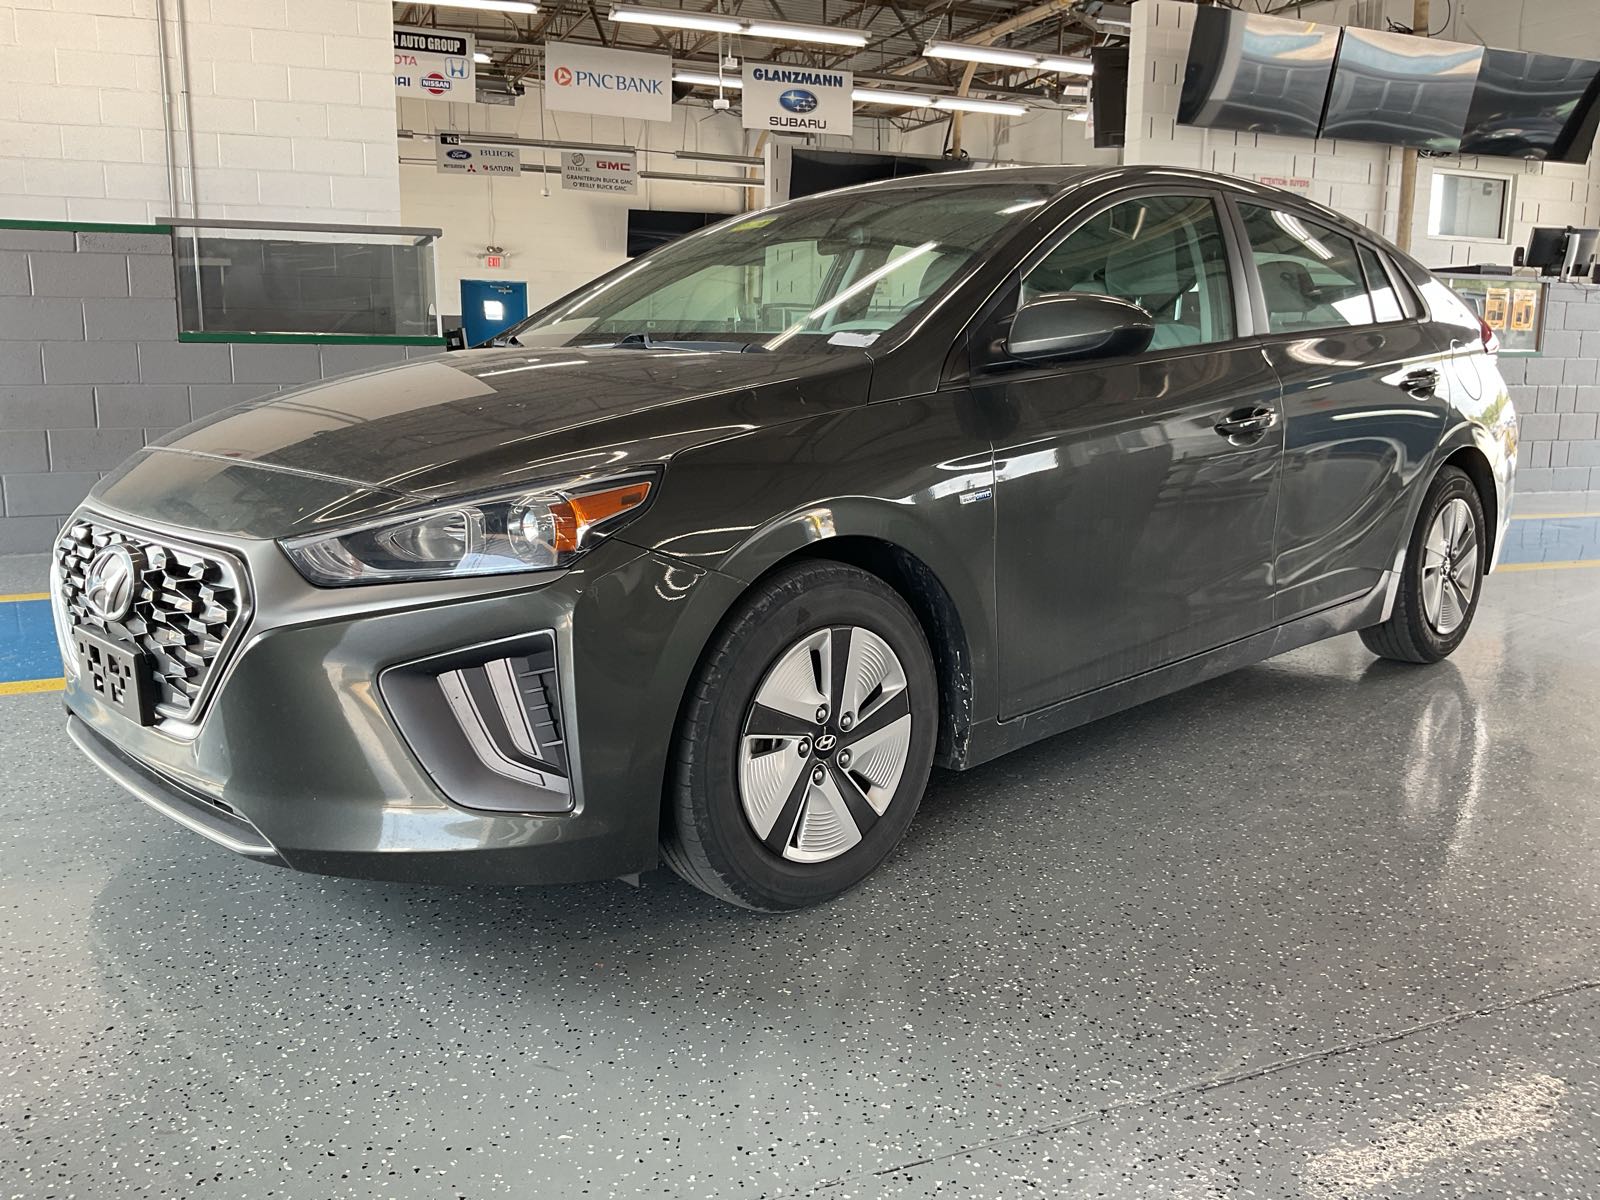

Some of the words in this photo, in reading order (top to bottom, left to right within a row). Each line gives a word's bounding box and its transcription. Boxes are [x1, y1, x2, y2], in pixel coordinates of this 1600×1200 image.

[400, 34, 426, 49] AUTO
[427, 37, 460, 53] GROUP
[753, 68, 843, 88] GLANZMANN
[422, 80, 450, 89] NISSAN
[769, 116, 827, 129] SUBARU
[451, 151, 467, 159] Ford
[480, 149, 515, 158] BUICK
[596, 160, 631, 172] GMC
